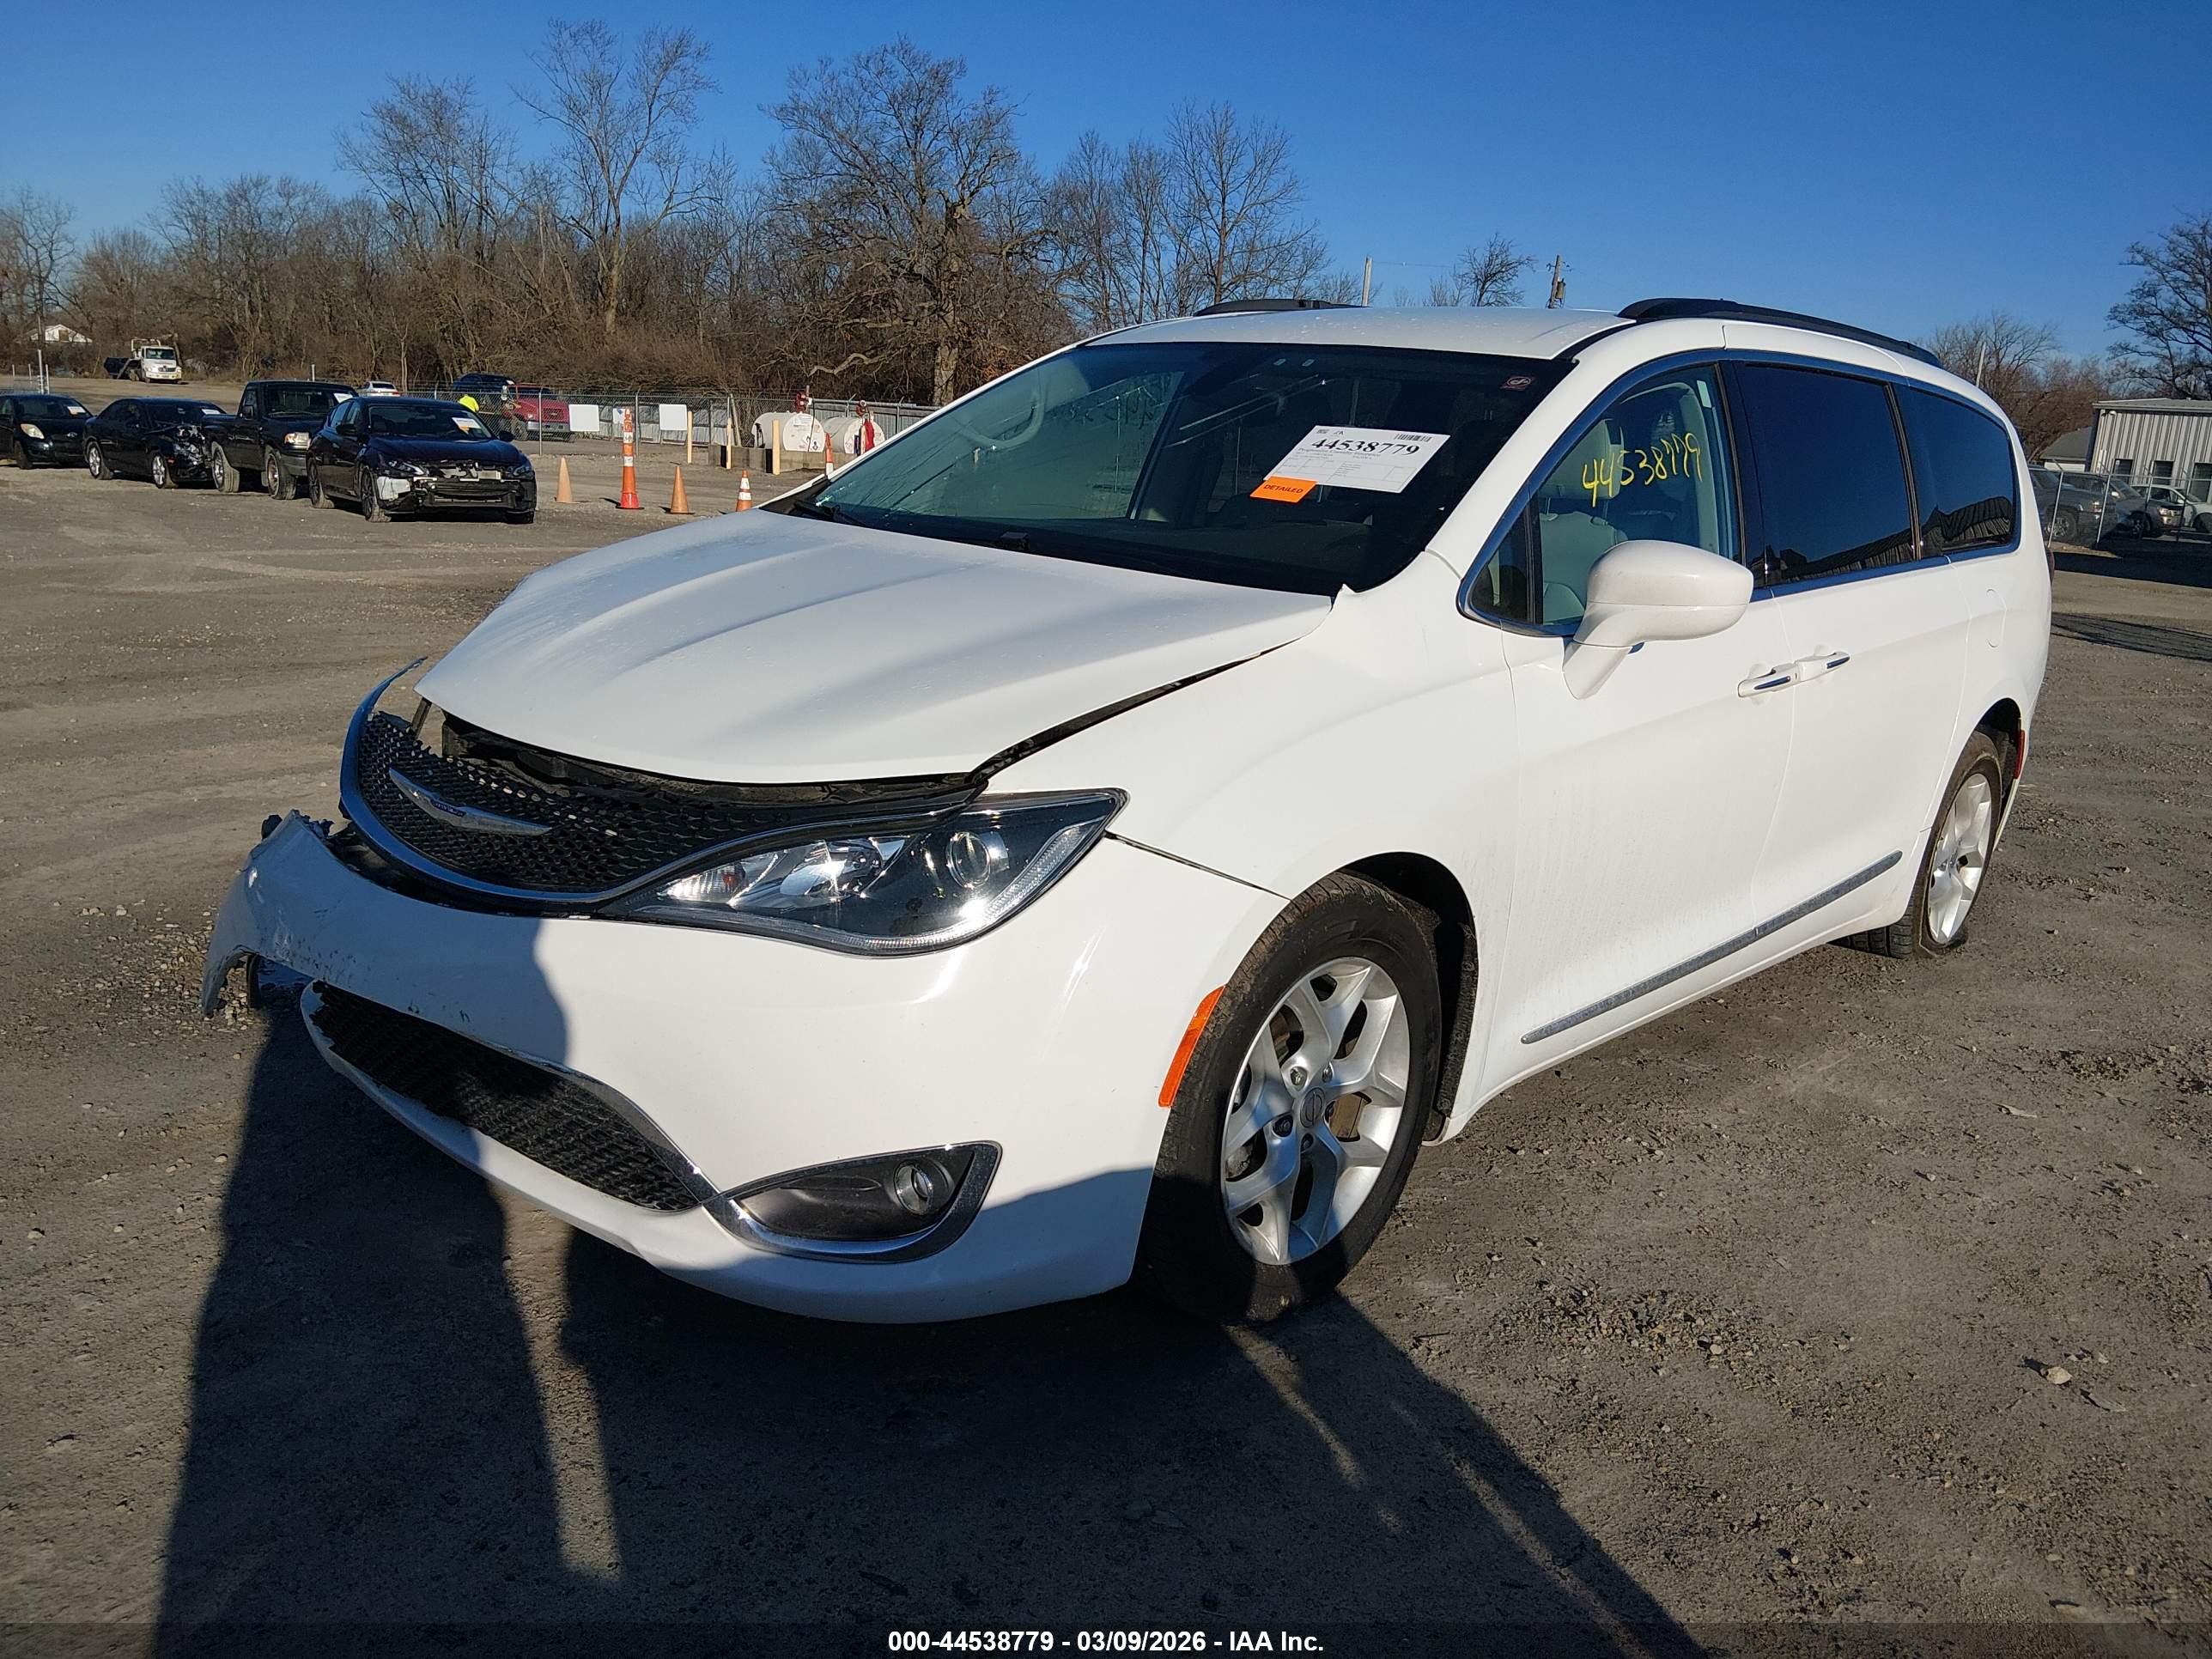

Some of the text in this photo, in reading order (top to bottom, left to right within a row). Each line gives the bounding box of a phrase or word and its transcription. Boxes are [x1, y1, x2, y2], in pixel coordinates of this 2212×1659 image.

[1311, 438, 1420, 457] 44538779
[1583, 432, 1703, 508] 44538779
[1263, 483, 1304, 495] DETAILED
